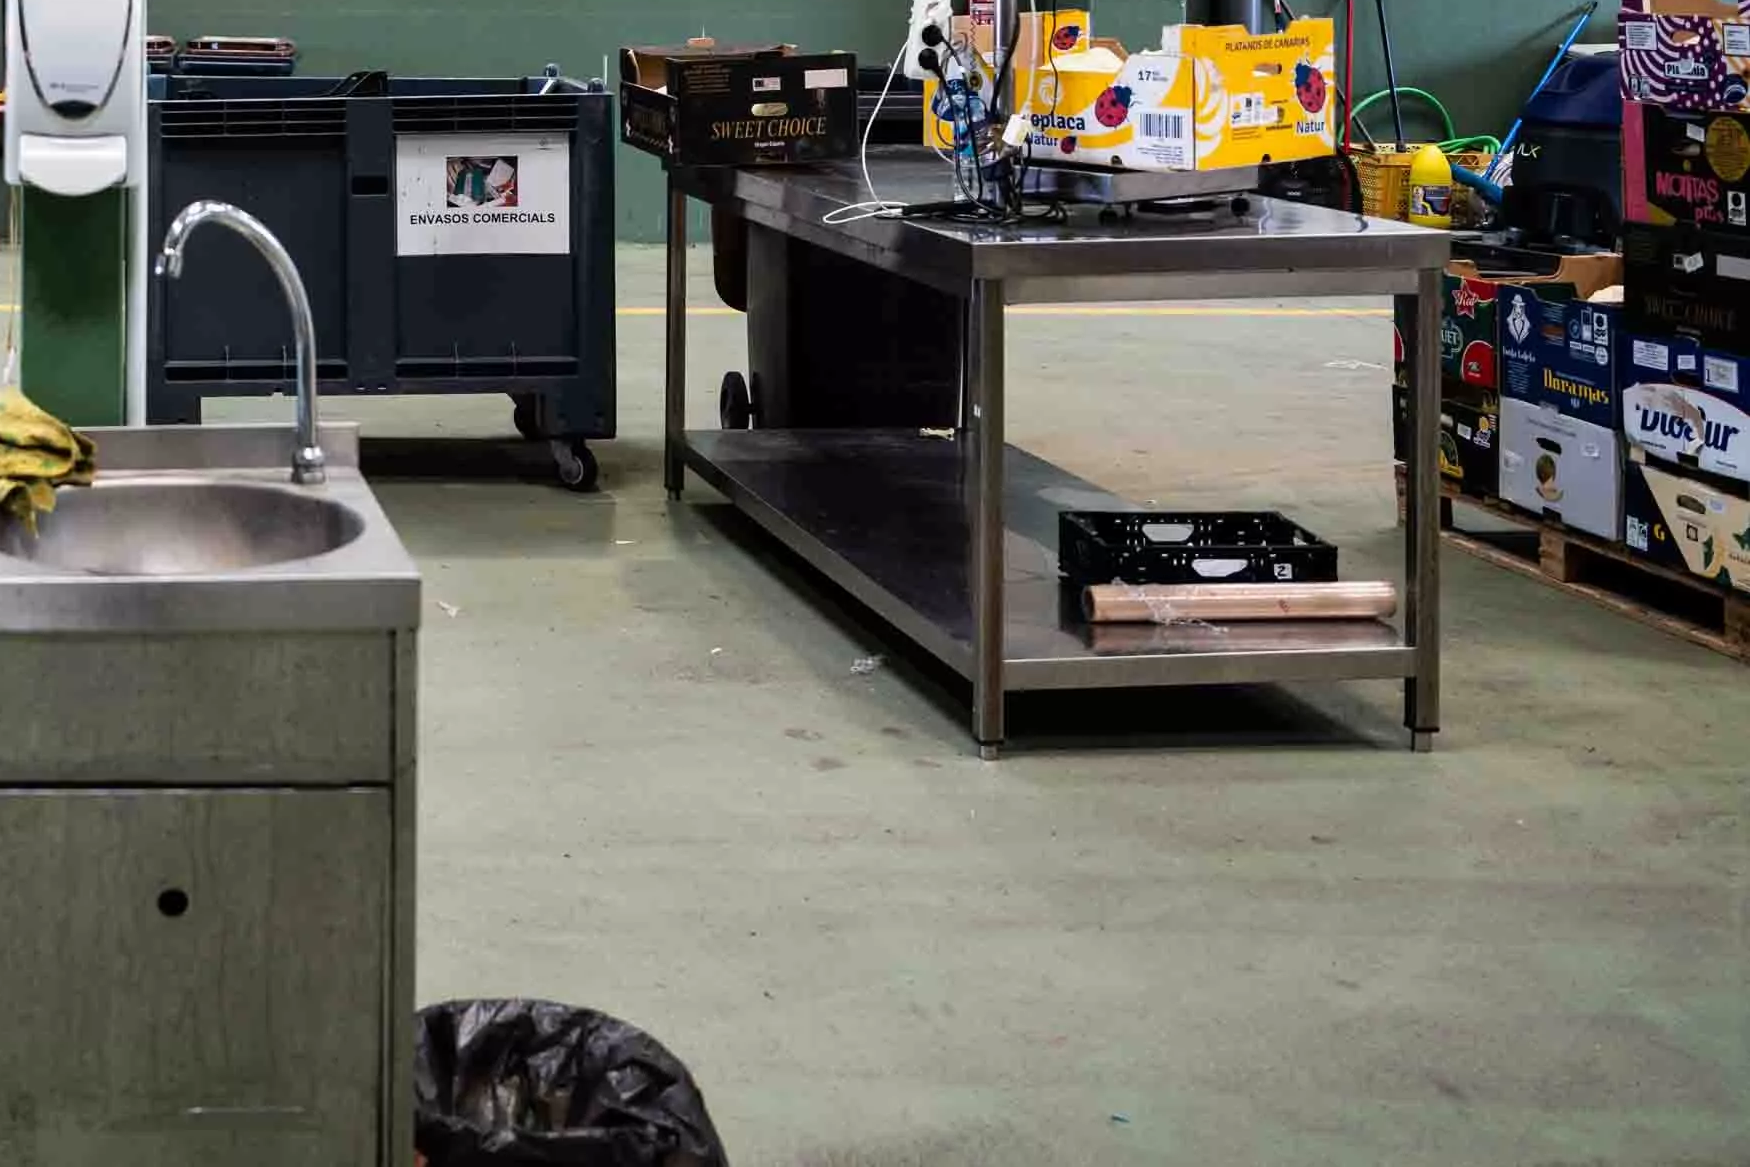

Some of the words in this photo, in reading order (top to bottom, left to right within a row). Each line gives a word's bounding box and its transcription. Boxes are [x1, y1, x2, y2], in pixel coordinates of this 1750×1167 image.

[1137, 70, 1152, 82] 17
[711, 119, 764, 140] SWEET
[767, 116, 827, 138] CHOICE
[1296, 121, 1325, 134] Natur
[410, 213, 469, 225] ENVASOS
[472, 212, 555, 224] COMERCIALS
[1277, 565, 1288, 577] 2
